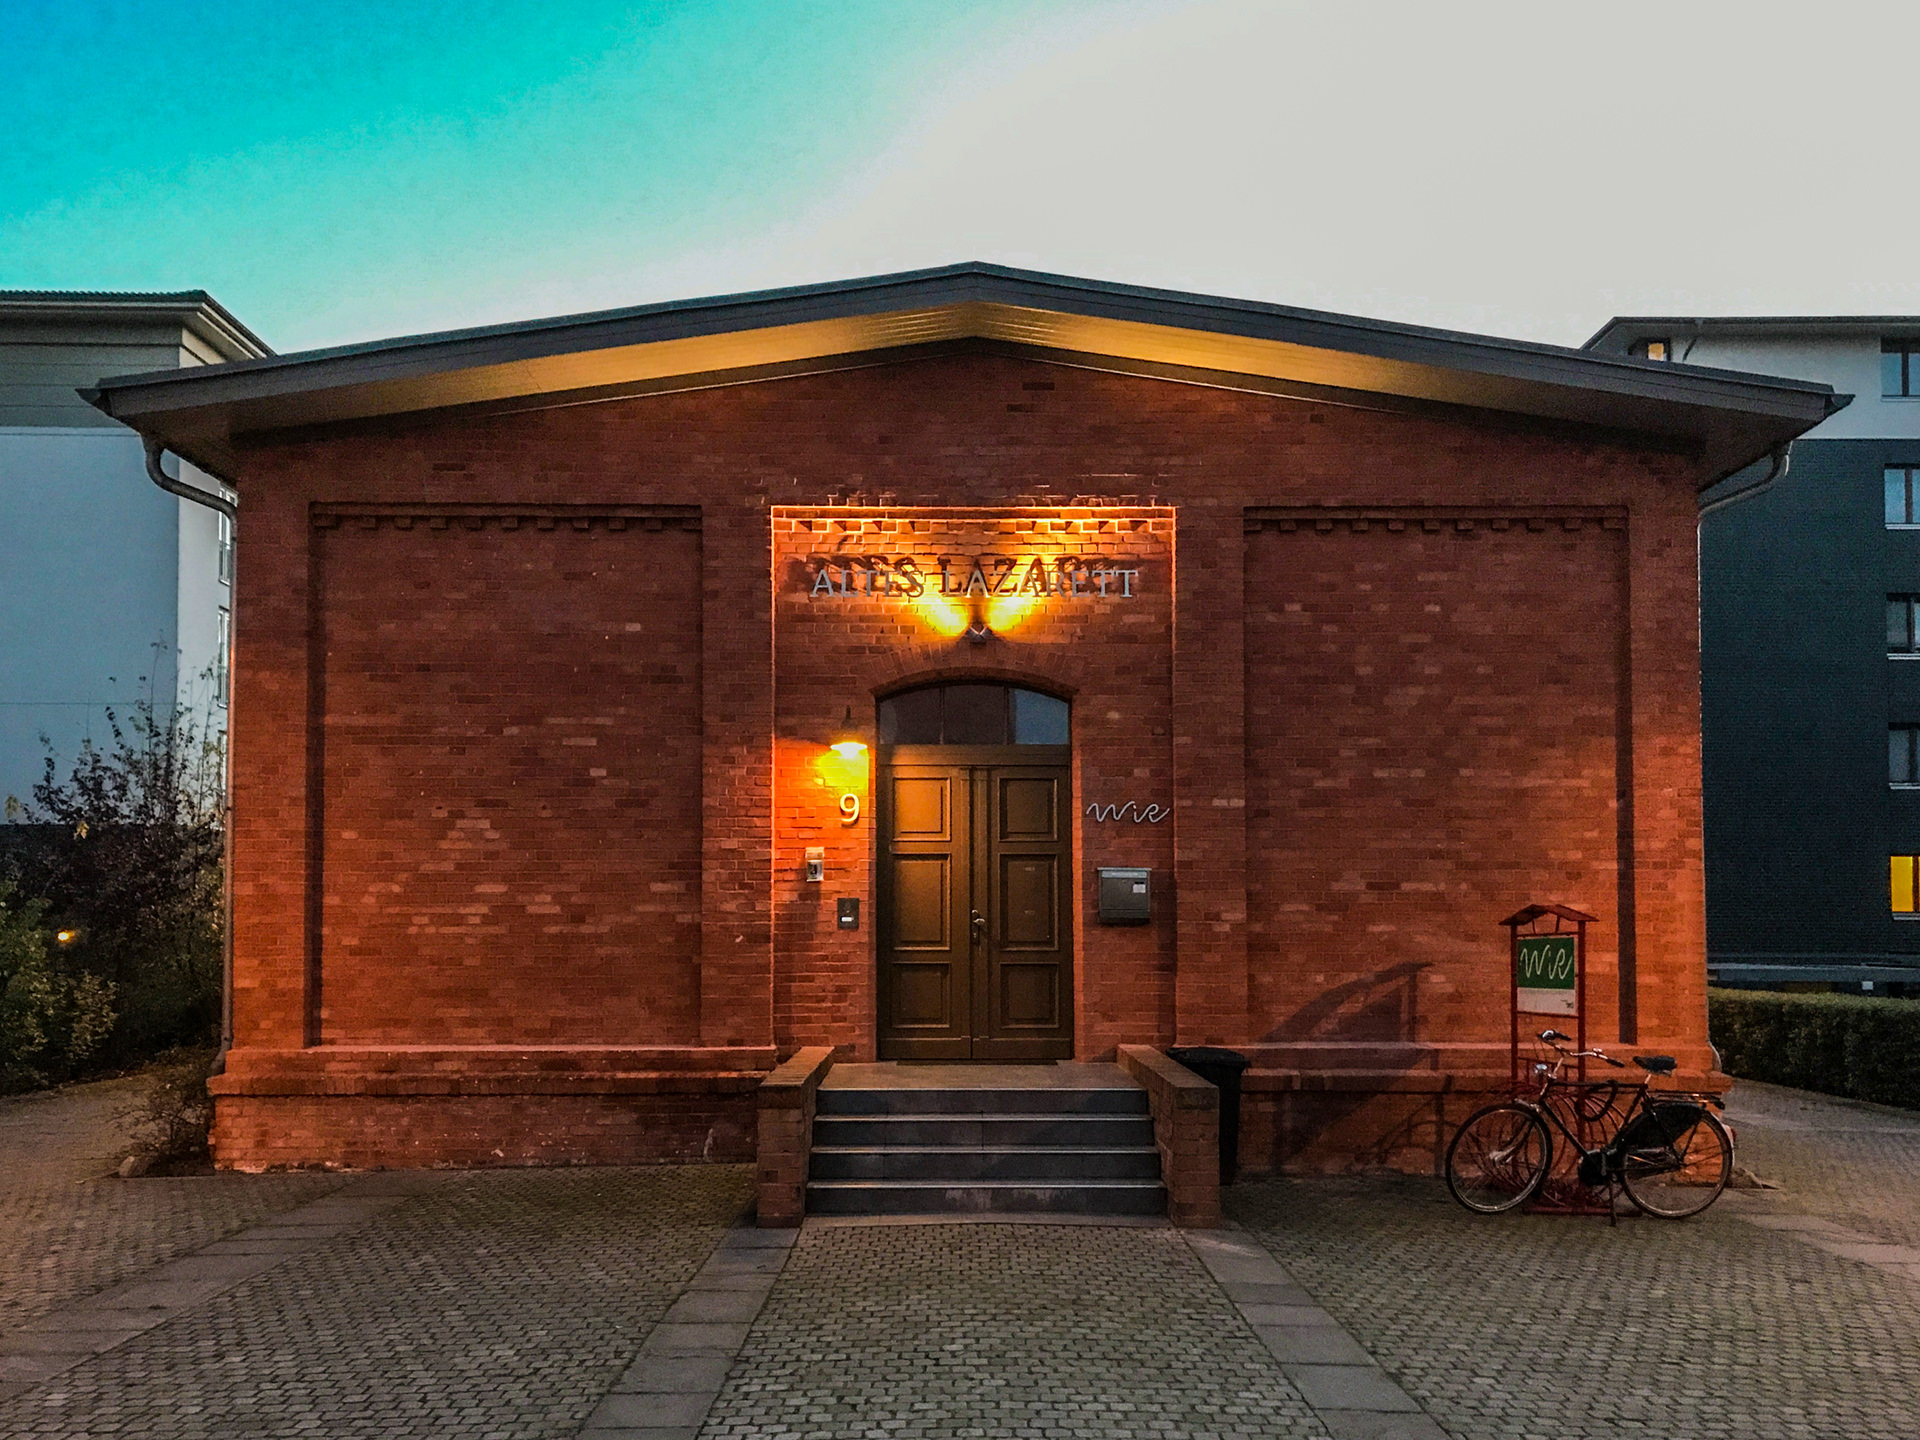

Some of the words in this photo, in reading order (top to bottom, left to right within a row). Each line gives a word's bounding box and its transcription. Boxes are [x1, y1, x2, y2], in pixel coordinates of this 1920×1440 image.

[810, 569, 925, 598] ALTES
[942, 569, 1138, 598] LAZARETT
[840, 793, 860, 822] 9
